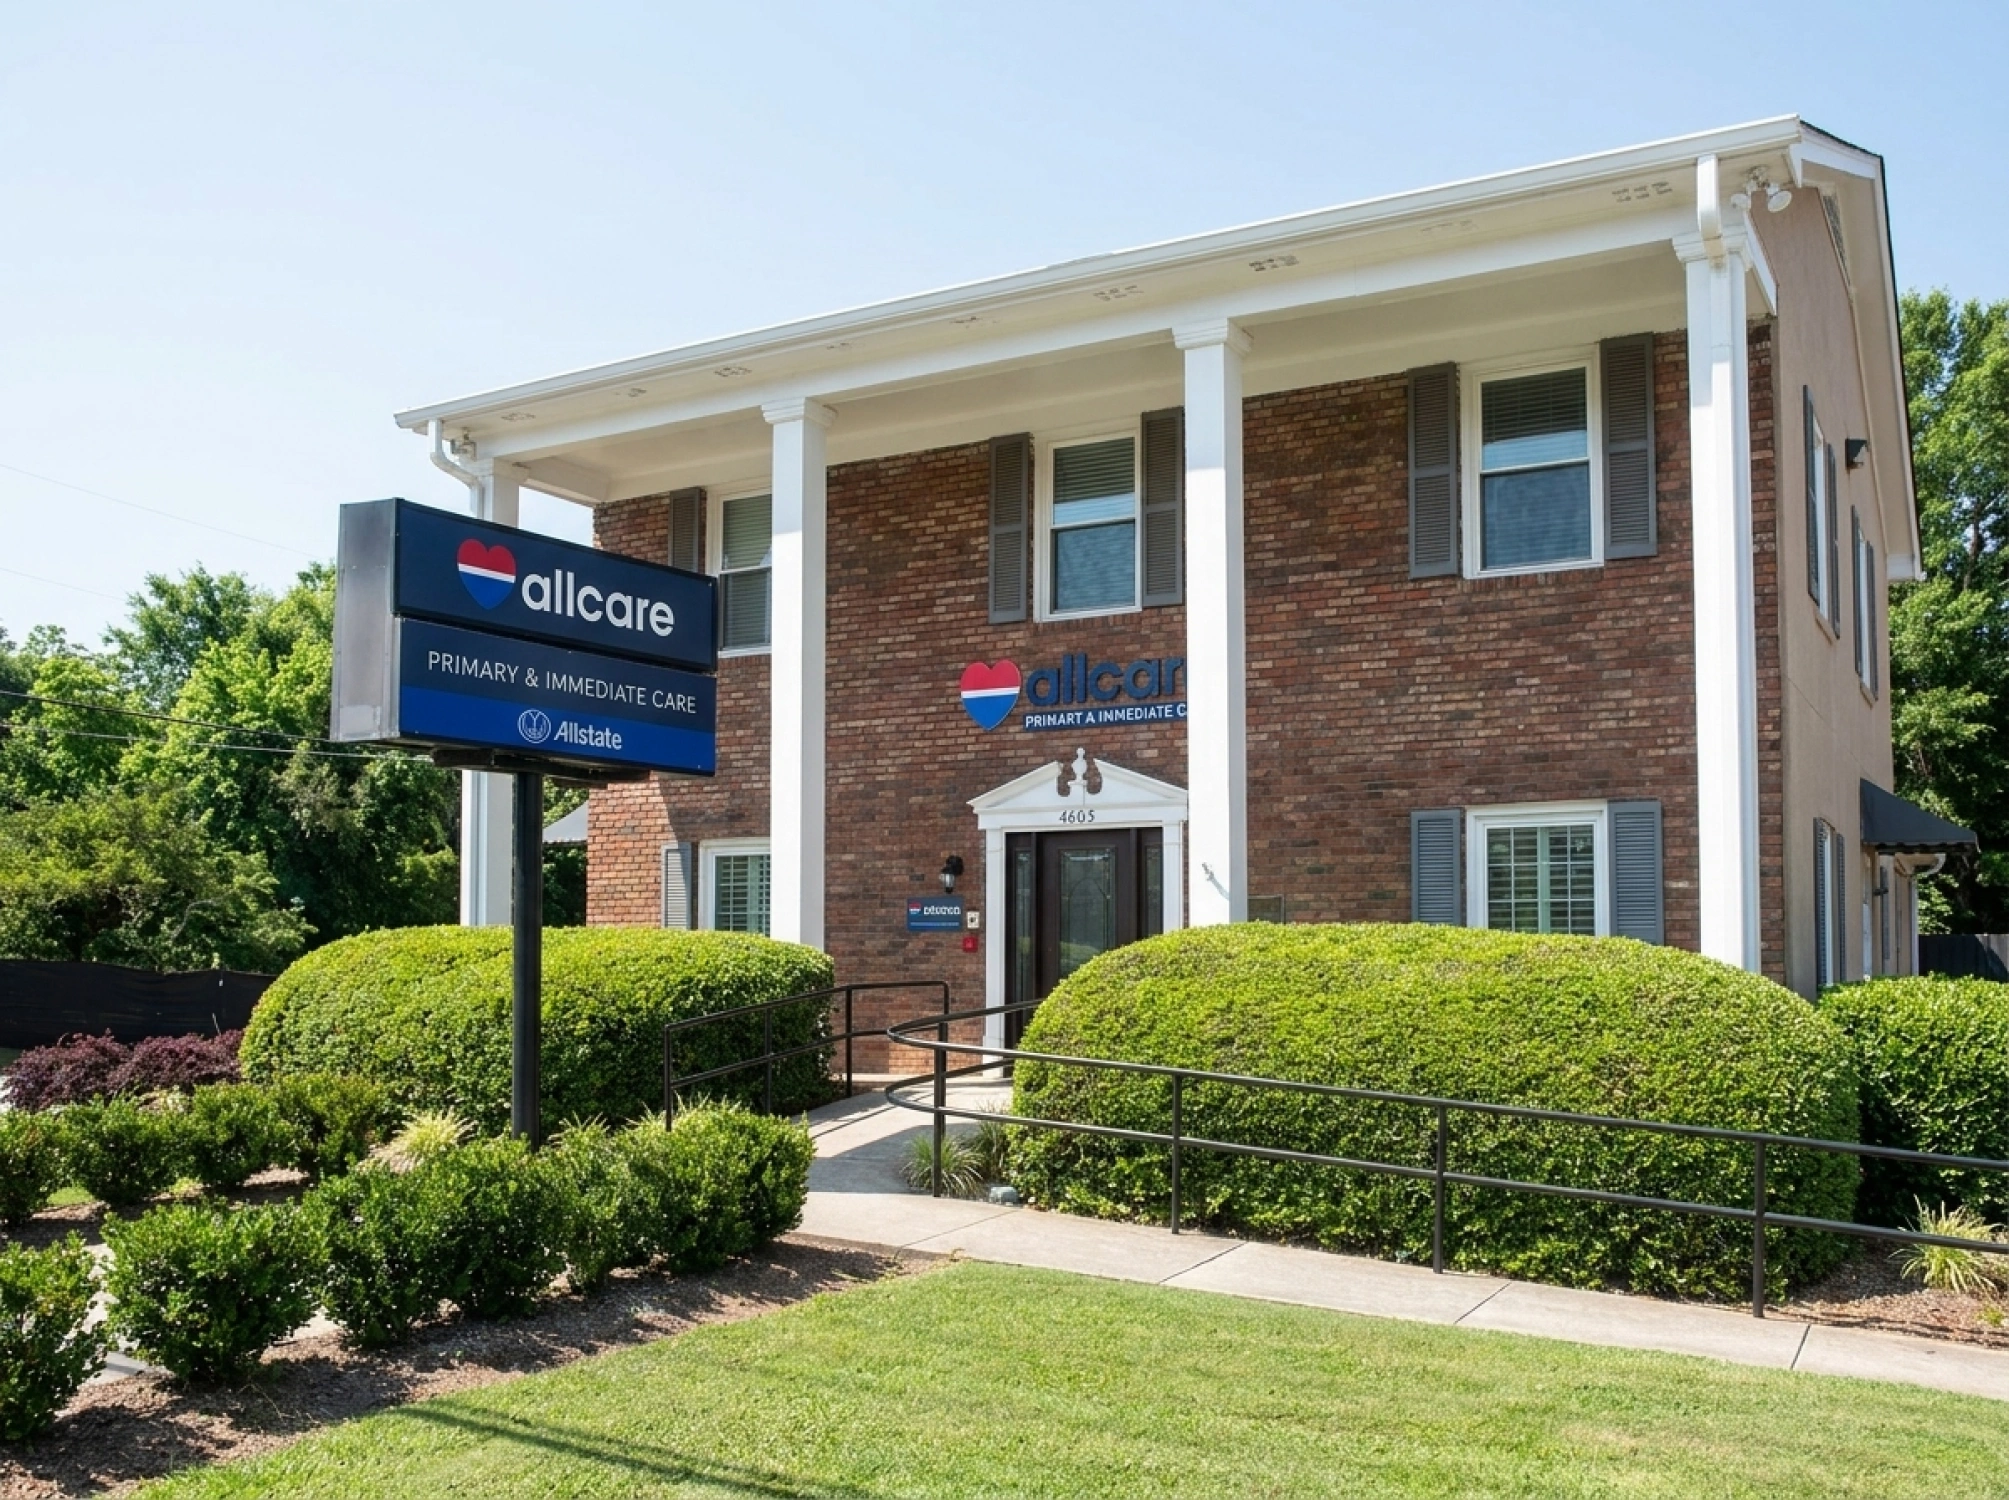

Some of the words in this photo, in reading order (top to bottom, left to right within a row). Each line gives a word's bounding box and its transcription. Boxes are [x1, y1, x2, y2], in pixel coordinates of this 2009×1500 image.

[521, 568, 675, 637] allcare
[428, 650, 519, 684] PRIMARY
[525, 668, 539, 688] &
[546, 671, 647, 706] IMMEDIATE
[652, 690, 697, 714] CARE
[1027, 653, 1187, 706] allcar
[554, 721, 622, 750] Allstate
[1059, 809, 1096, 824] 4605
